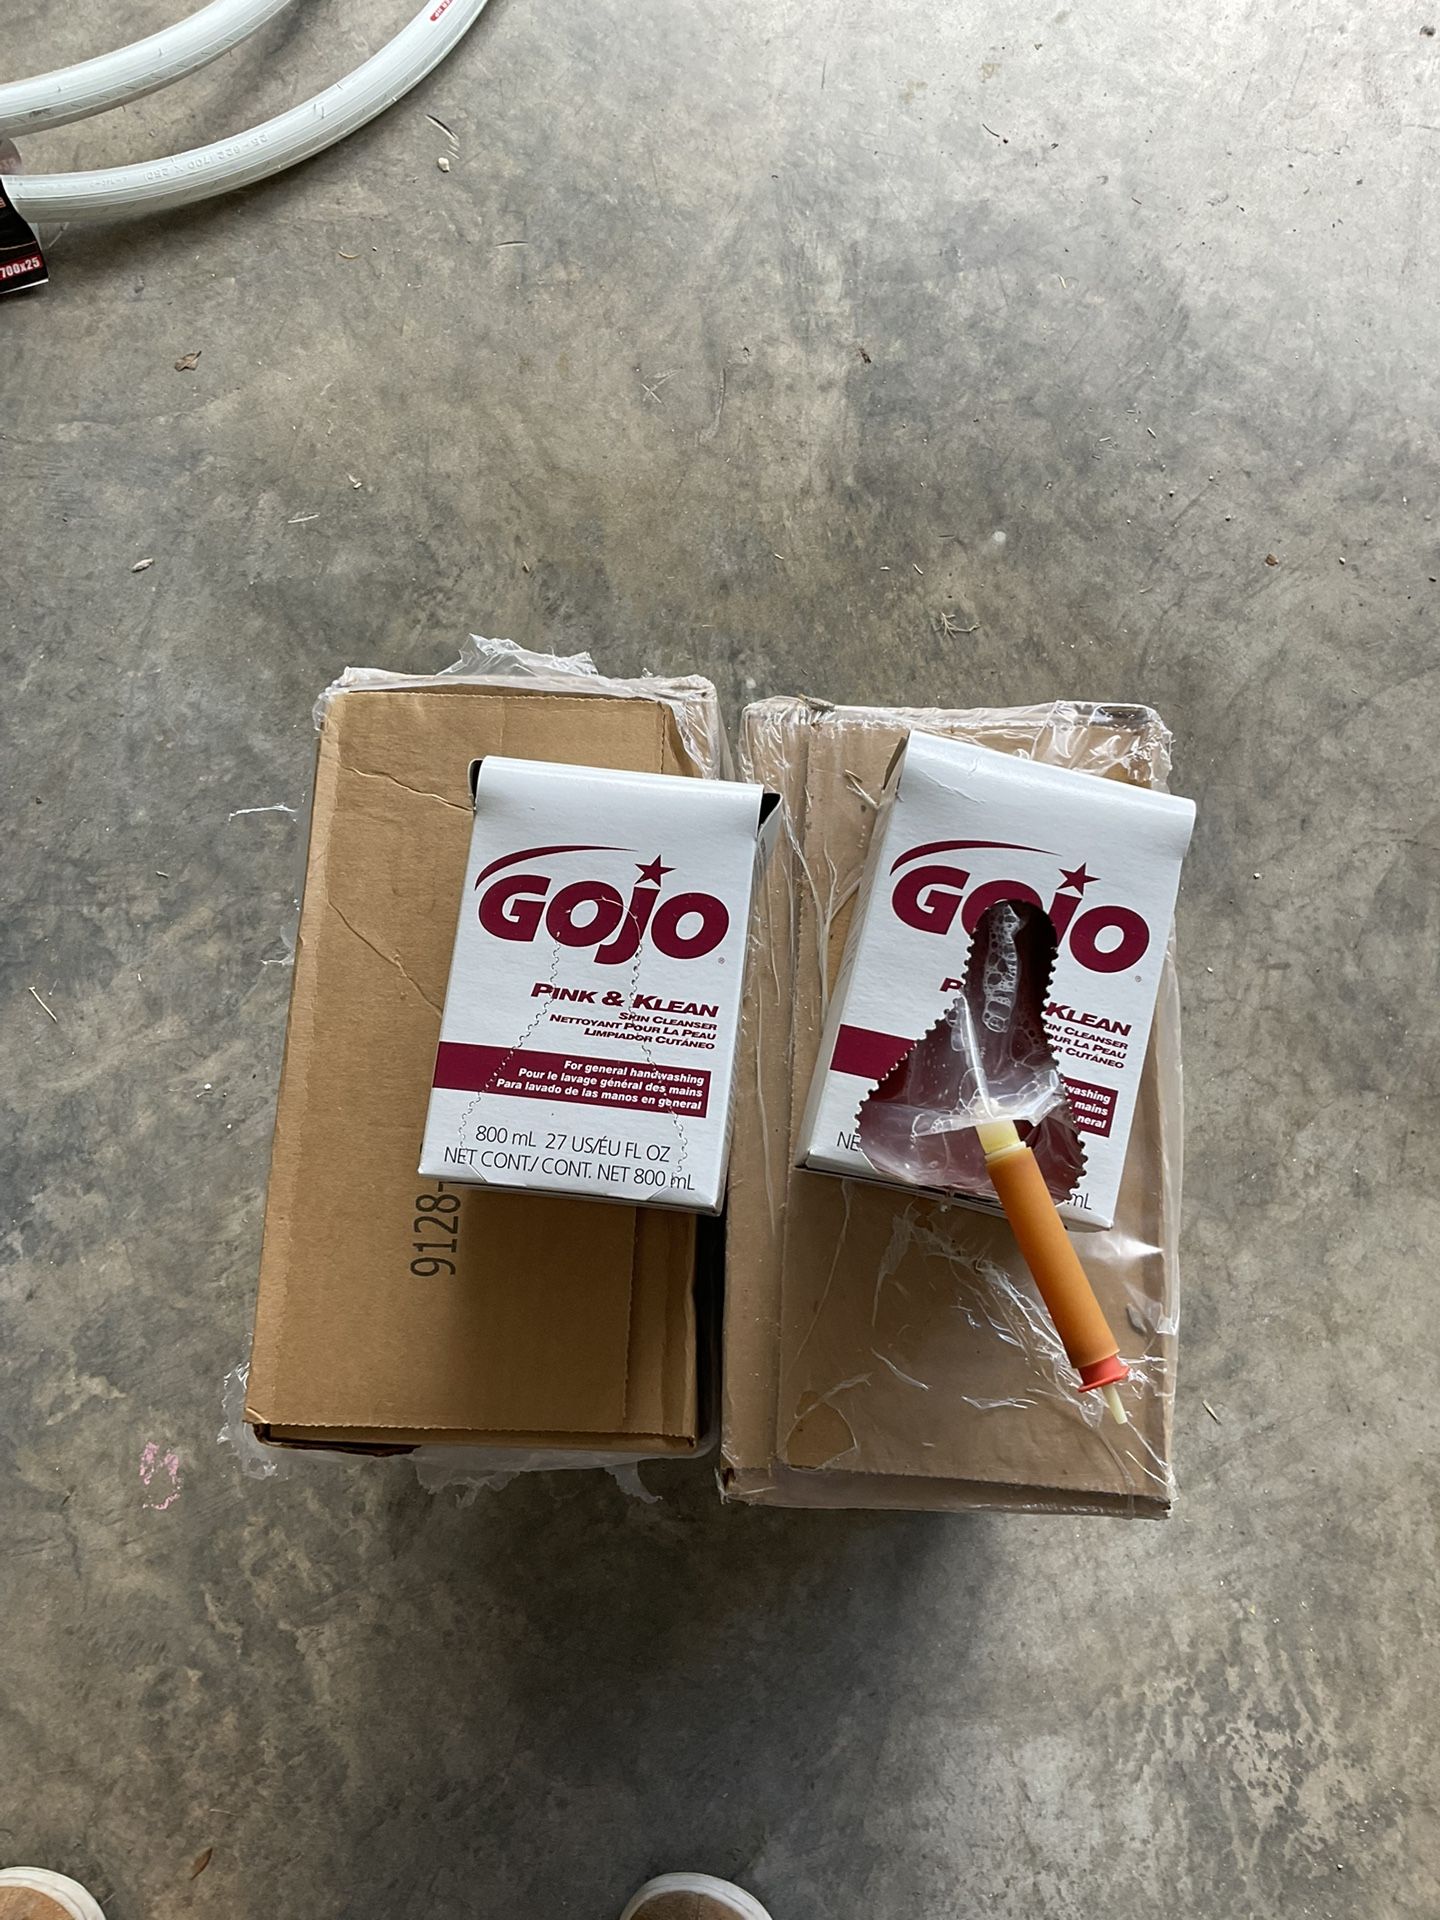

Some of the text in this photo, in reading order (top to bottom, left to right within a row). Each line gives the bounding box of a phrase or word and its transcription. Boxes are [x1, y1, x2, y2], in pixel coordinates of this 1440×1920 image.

[0, 257, 41, 279] 700x25
[478, 874, 730, 965] GOJO
[531, 982, 719, 1018] PINK & KLEAN
[549, 1013, 717, 1041] NETTOYANT POUR LA PEAU
[619, 1011, 718, 1031] SKIN CLEANSER
[1045, 1001, 1132, 1037] KLEAN
[584, 1027, 653, 1043] LIMPIADOR
[1063, 1026, 1130, 1050] CLEANSER
[1073, 1039, 1090, 1050] LA
[1092, 1044, 1128, 1060] PEAU
[518, 1068, 704, 1098] Pour le lavage général des mains
[564, 1060, 705, 1087] For general handwashing
[496, 1078, 703, 1110] Para lavado de las manos en general
[1074, 1101, 1109, 1116] mains
[1077, 1114, 1108, 1129] neral
[475, 1125, 672, 1163] 800 mL 27 US/ÉU FL OZ
[836, 1131, 862, 1152] NE
[444, 1146, 478, 1165] NET
[541, 1157, 593, 1180] CONT.
[598, 1164, 632, 1183] NET
[633, 1168, 667, 1187] 800
[670, 1172, 697, 1191] mL
[410, 1181, 461, 1277] 91128-
